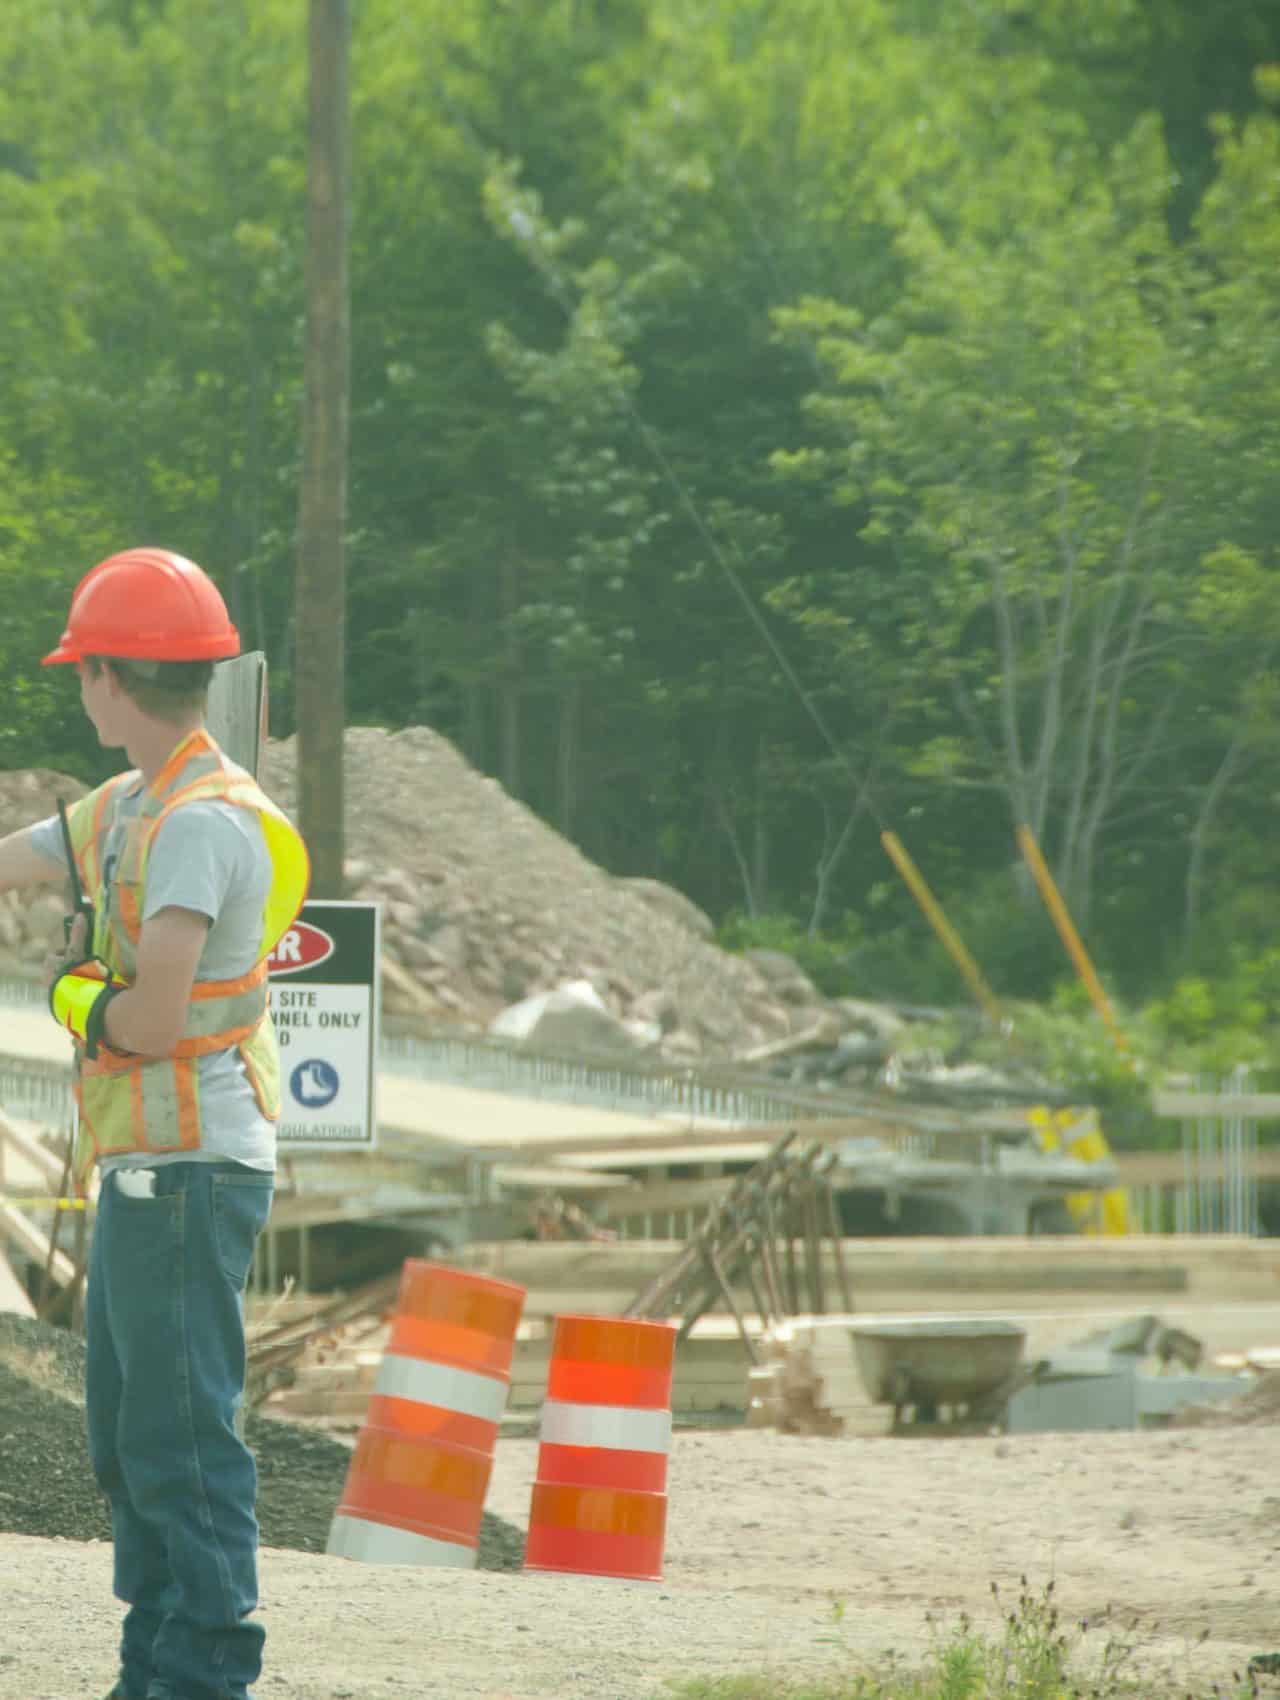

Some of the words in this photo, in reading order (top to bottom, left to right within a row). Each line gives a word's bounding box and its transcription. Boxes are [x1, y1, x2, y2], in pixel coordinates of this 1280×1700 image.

[267, 930, 302, 961] R
[279, 991, 317, 1007] SITE
[318, 1011, 361, 1029] ONLY
